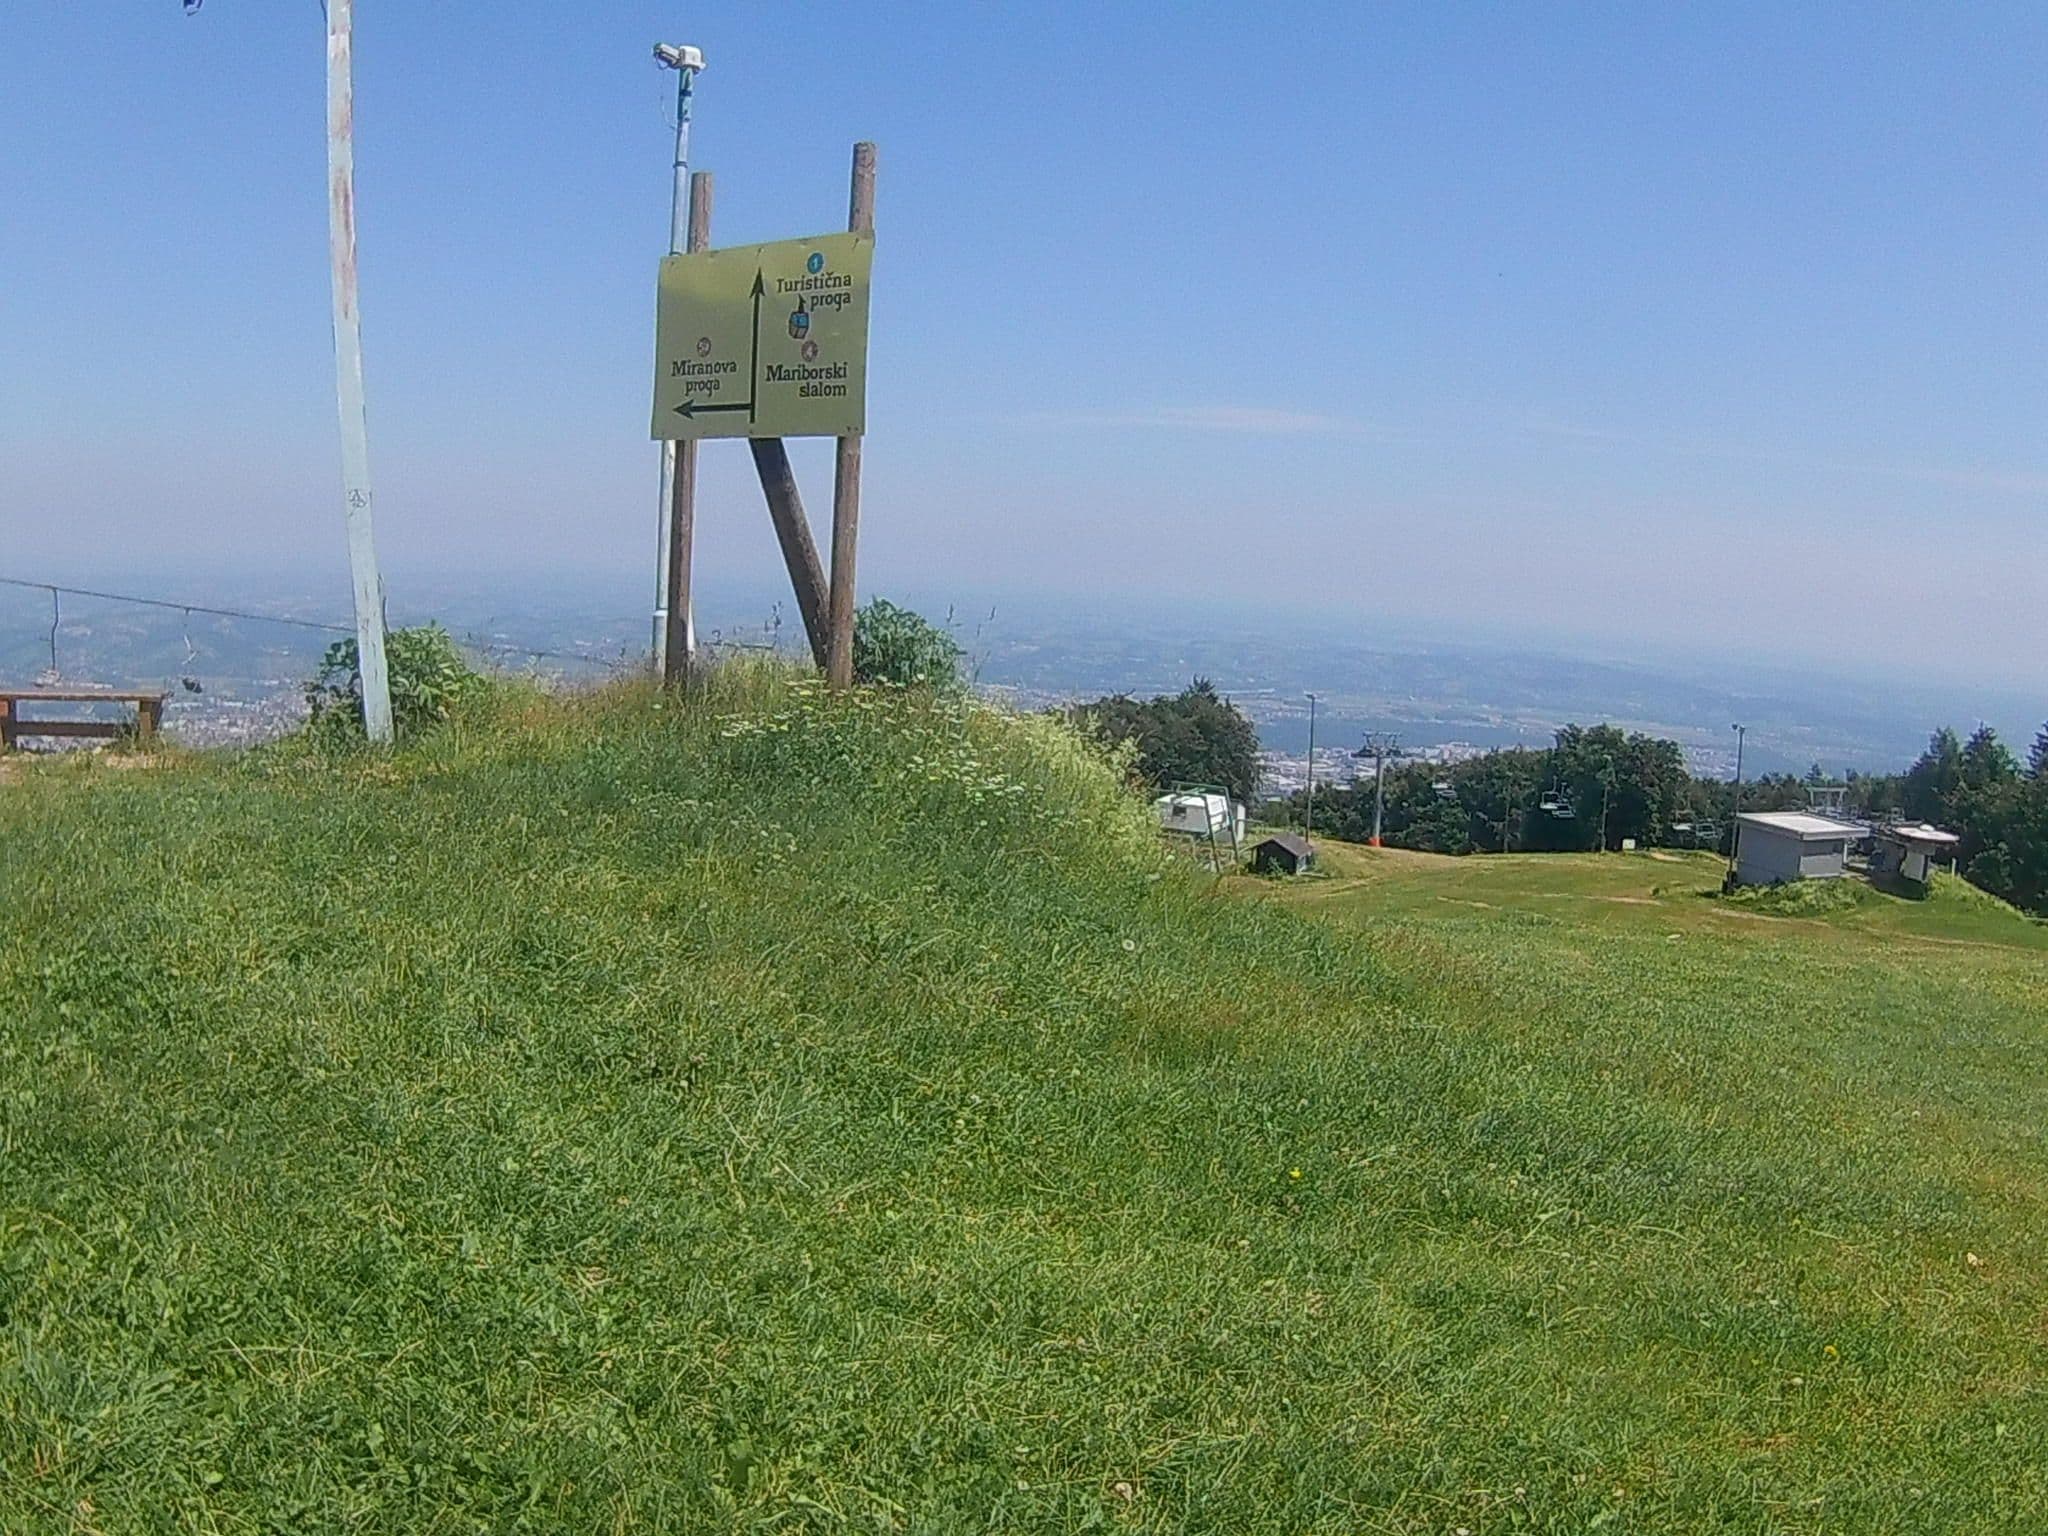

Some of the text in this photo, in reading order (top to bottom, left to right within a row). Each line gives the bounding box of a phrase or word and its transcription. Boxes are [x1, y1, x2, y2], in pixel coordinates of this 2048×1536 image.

[776, 272, 851, 293] Turistična
[811, 292, 851, 312] proga
[672, 360, 737, 376] Miranova
[766, 361, 847, 381] Mariborski
[685, 379, 720, 397] proga
[799, 382, 847, 397] slalom
